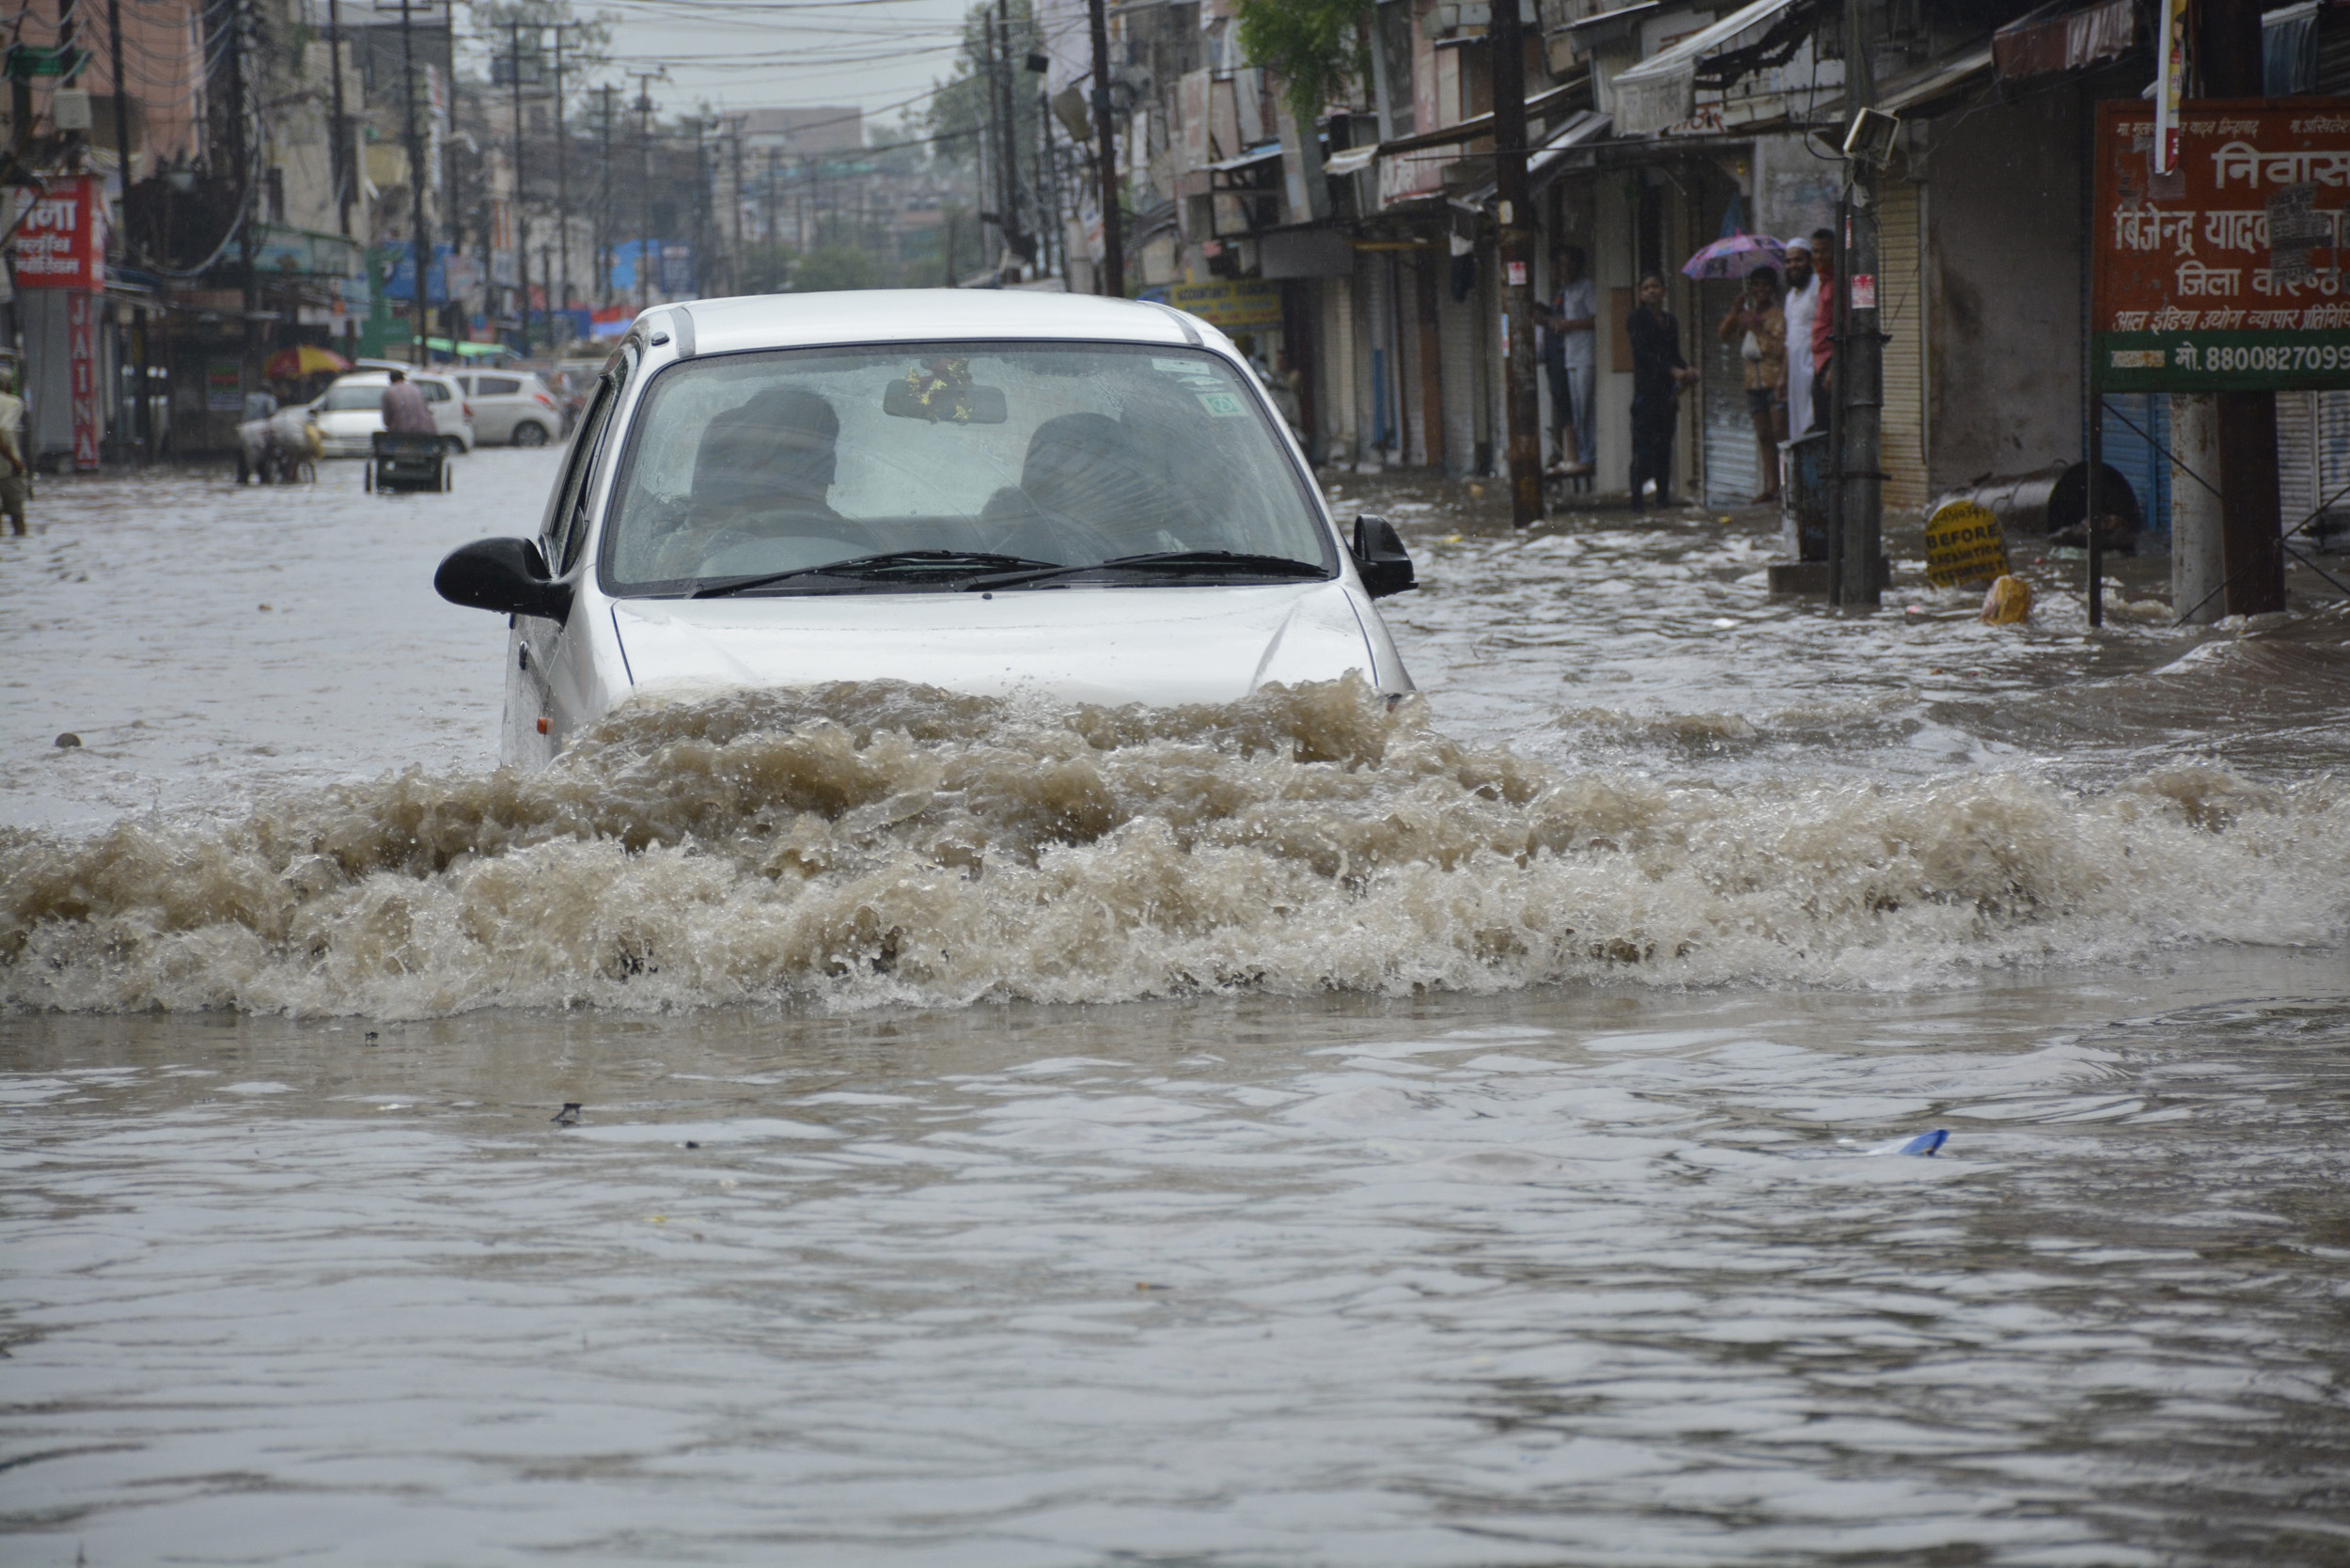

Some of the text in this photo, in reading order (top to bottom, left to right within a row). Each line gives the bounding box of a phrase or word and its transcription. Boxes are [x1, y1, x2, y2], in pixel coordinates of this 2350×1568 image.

[2188, 121, 2217, 138] यादव
[2113, 201, 2196, 257] बिजेन्द्र
[2204, 210, 2271, 255] यादव
[2175, 259, 2242, 297] जिला
[2112, 310, 2150, 333] आल
[2248, 309, 2300, 330] व्यापार
[2205, 345, 2350, 372] 8800827099
[1926, 524, 1997, 549] BEFORE
